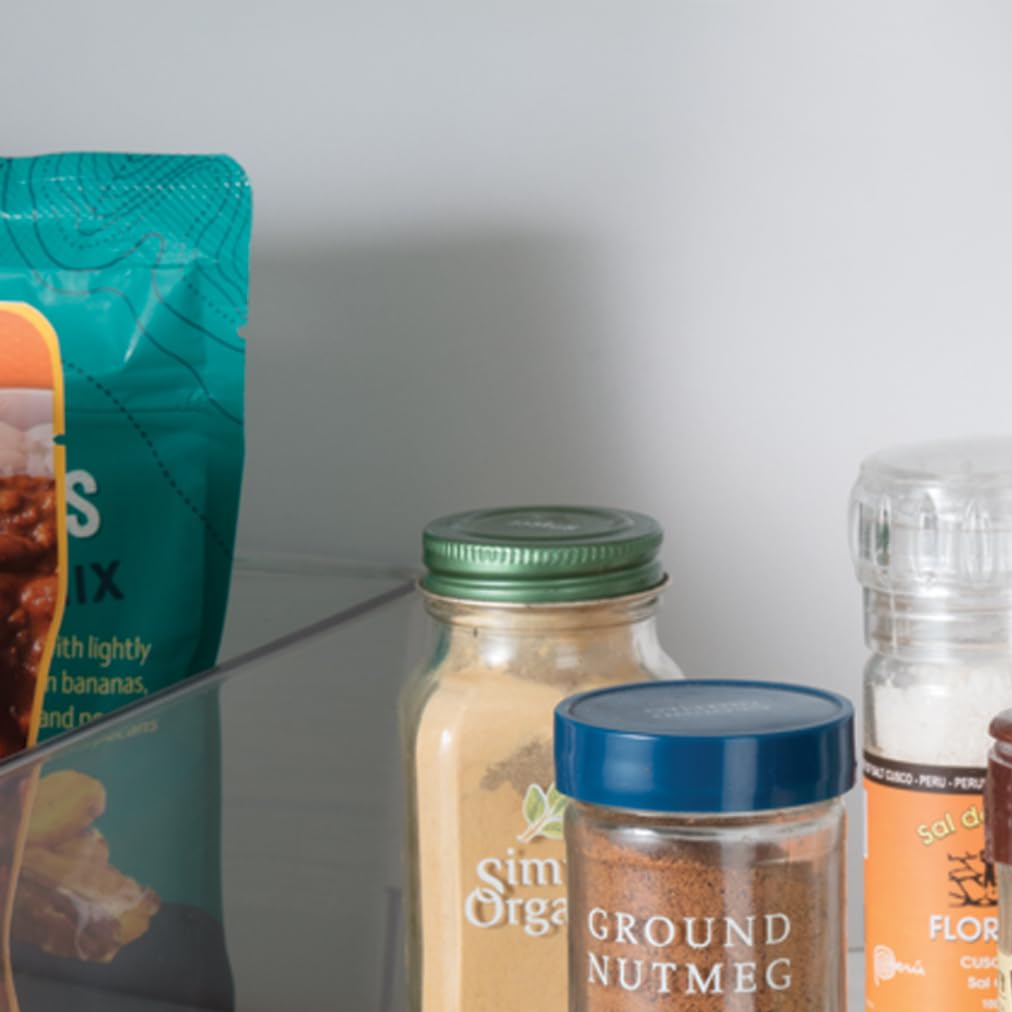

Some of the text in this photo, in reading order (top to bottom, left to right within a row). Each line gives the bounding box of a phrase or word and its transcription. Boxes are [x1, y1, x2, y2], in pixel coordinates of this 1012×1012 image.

[66, 560, 124, 606] IX
[88, 635, 152, 666] lightly
[62, 671, 148, 695] bananas,
[916, 811, 956, 847] Sal
[476, 847, 567, 896] Sim
[587, 906, 792, 949] GROUND
[929, 914, 999, 943] FLOR
[587, 952, 793, 994] NUTMEG
